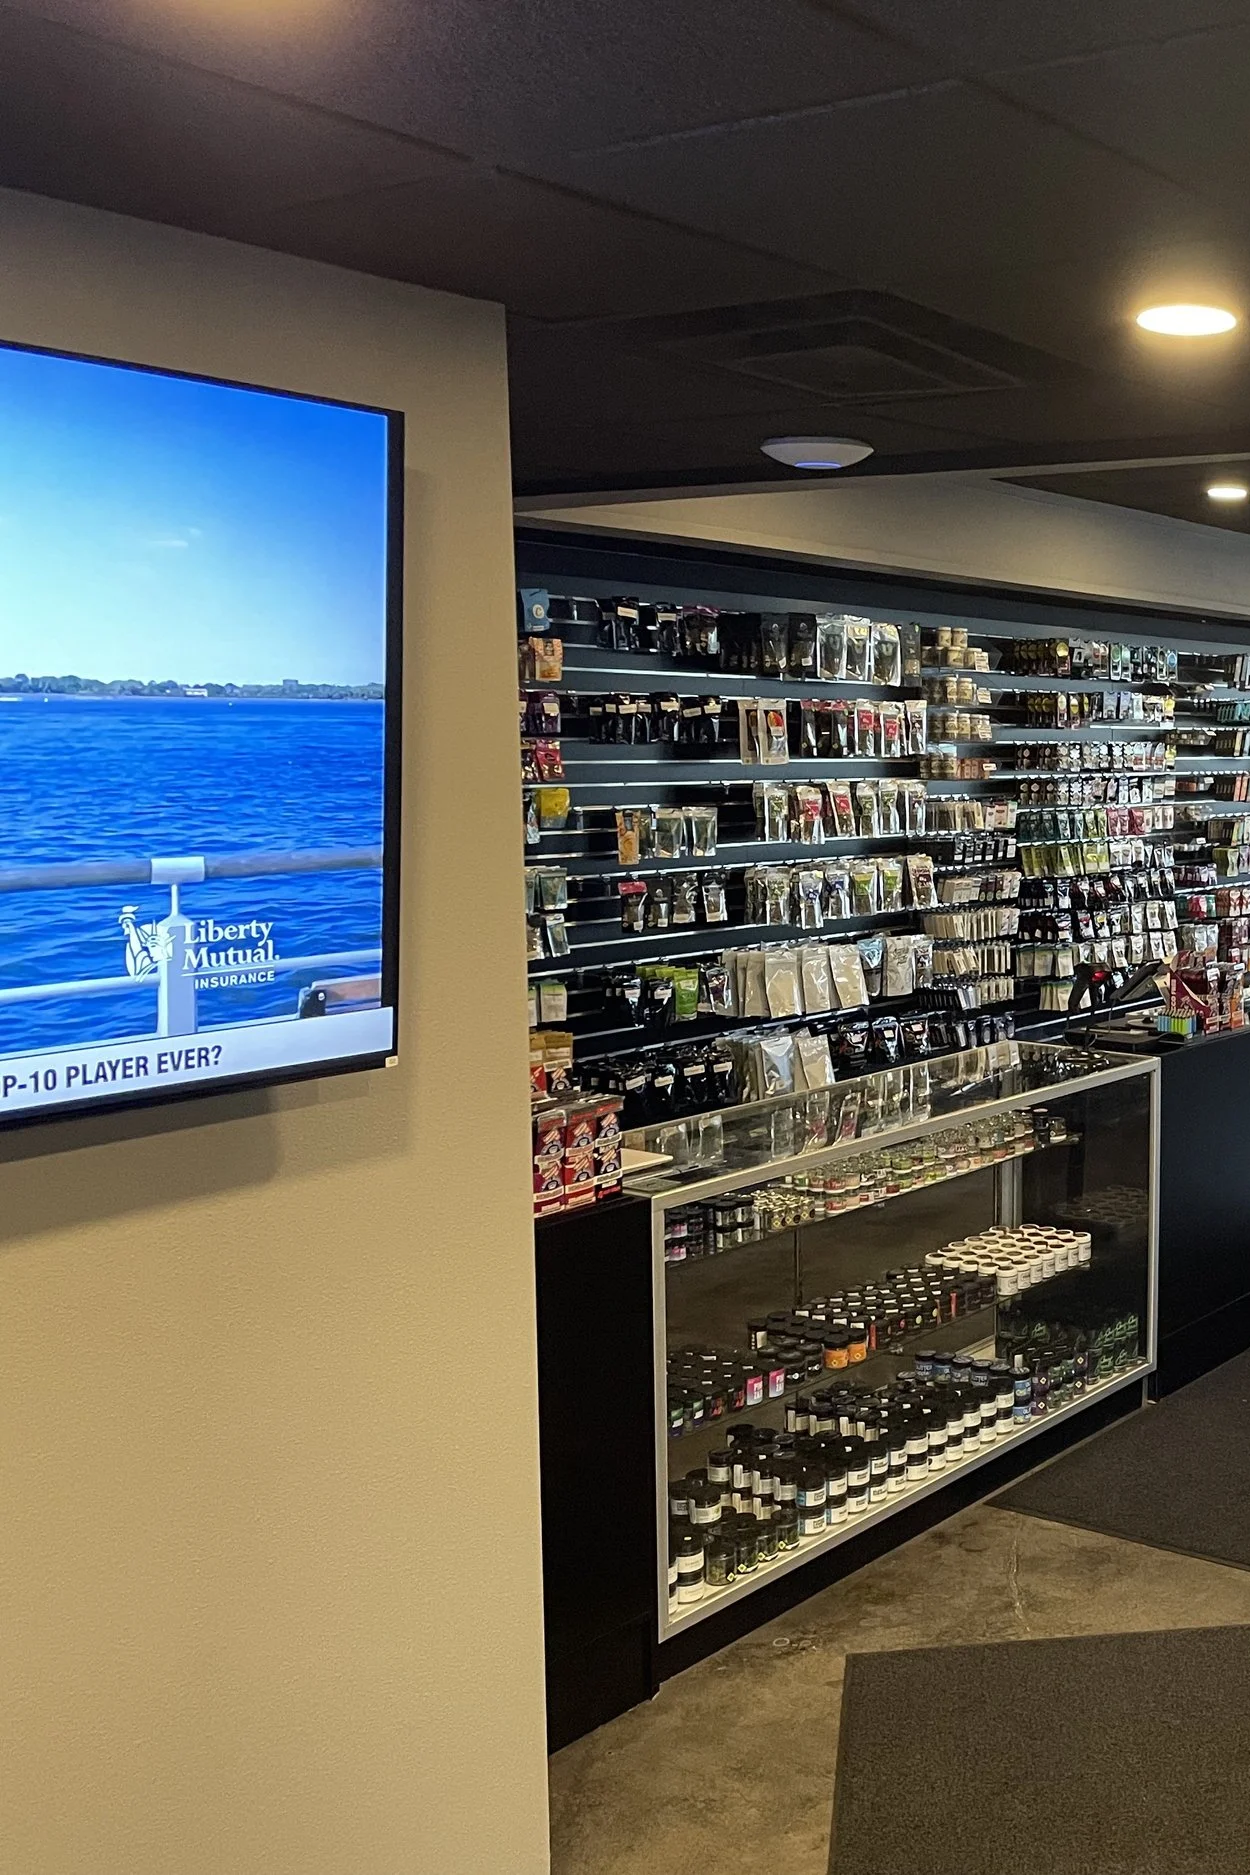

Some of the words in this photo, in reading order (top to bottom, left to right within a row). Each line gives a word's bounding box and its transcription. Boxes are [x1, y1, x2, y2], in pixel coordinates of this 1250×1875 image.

[183, 918, 274, 946] Liberty
[194, 970, 275, 990] INSURANCE
[2, 1068, 58, 1098] P-10
[65, 1055, 149, 1089] PLAYER
[157, 1044, 224, 1074] EVER?
